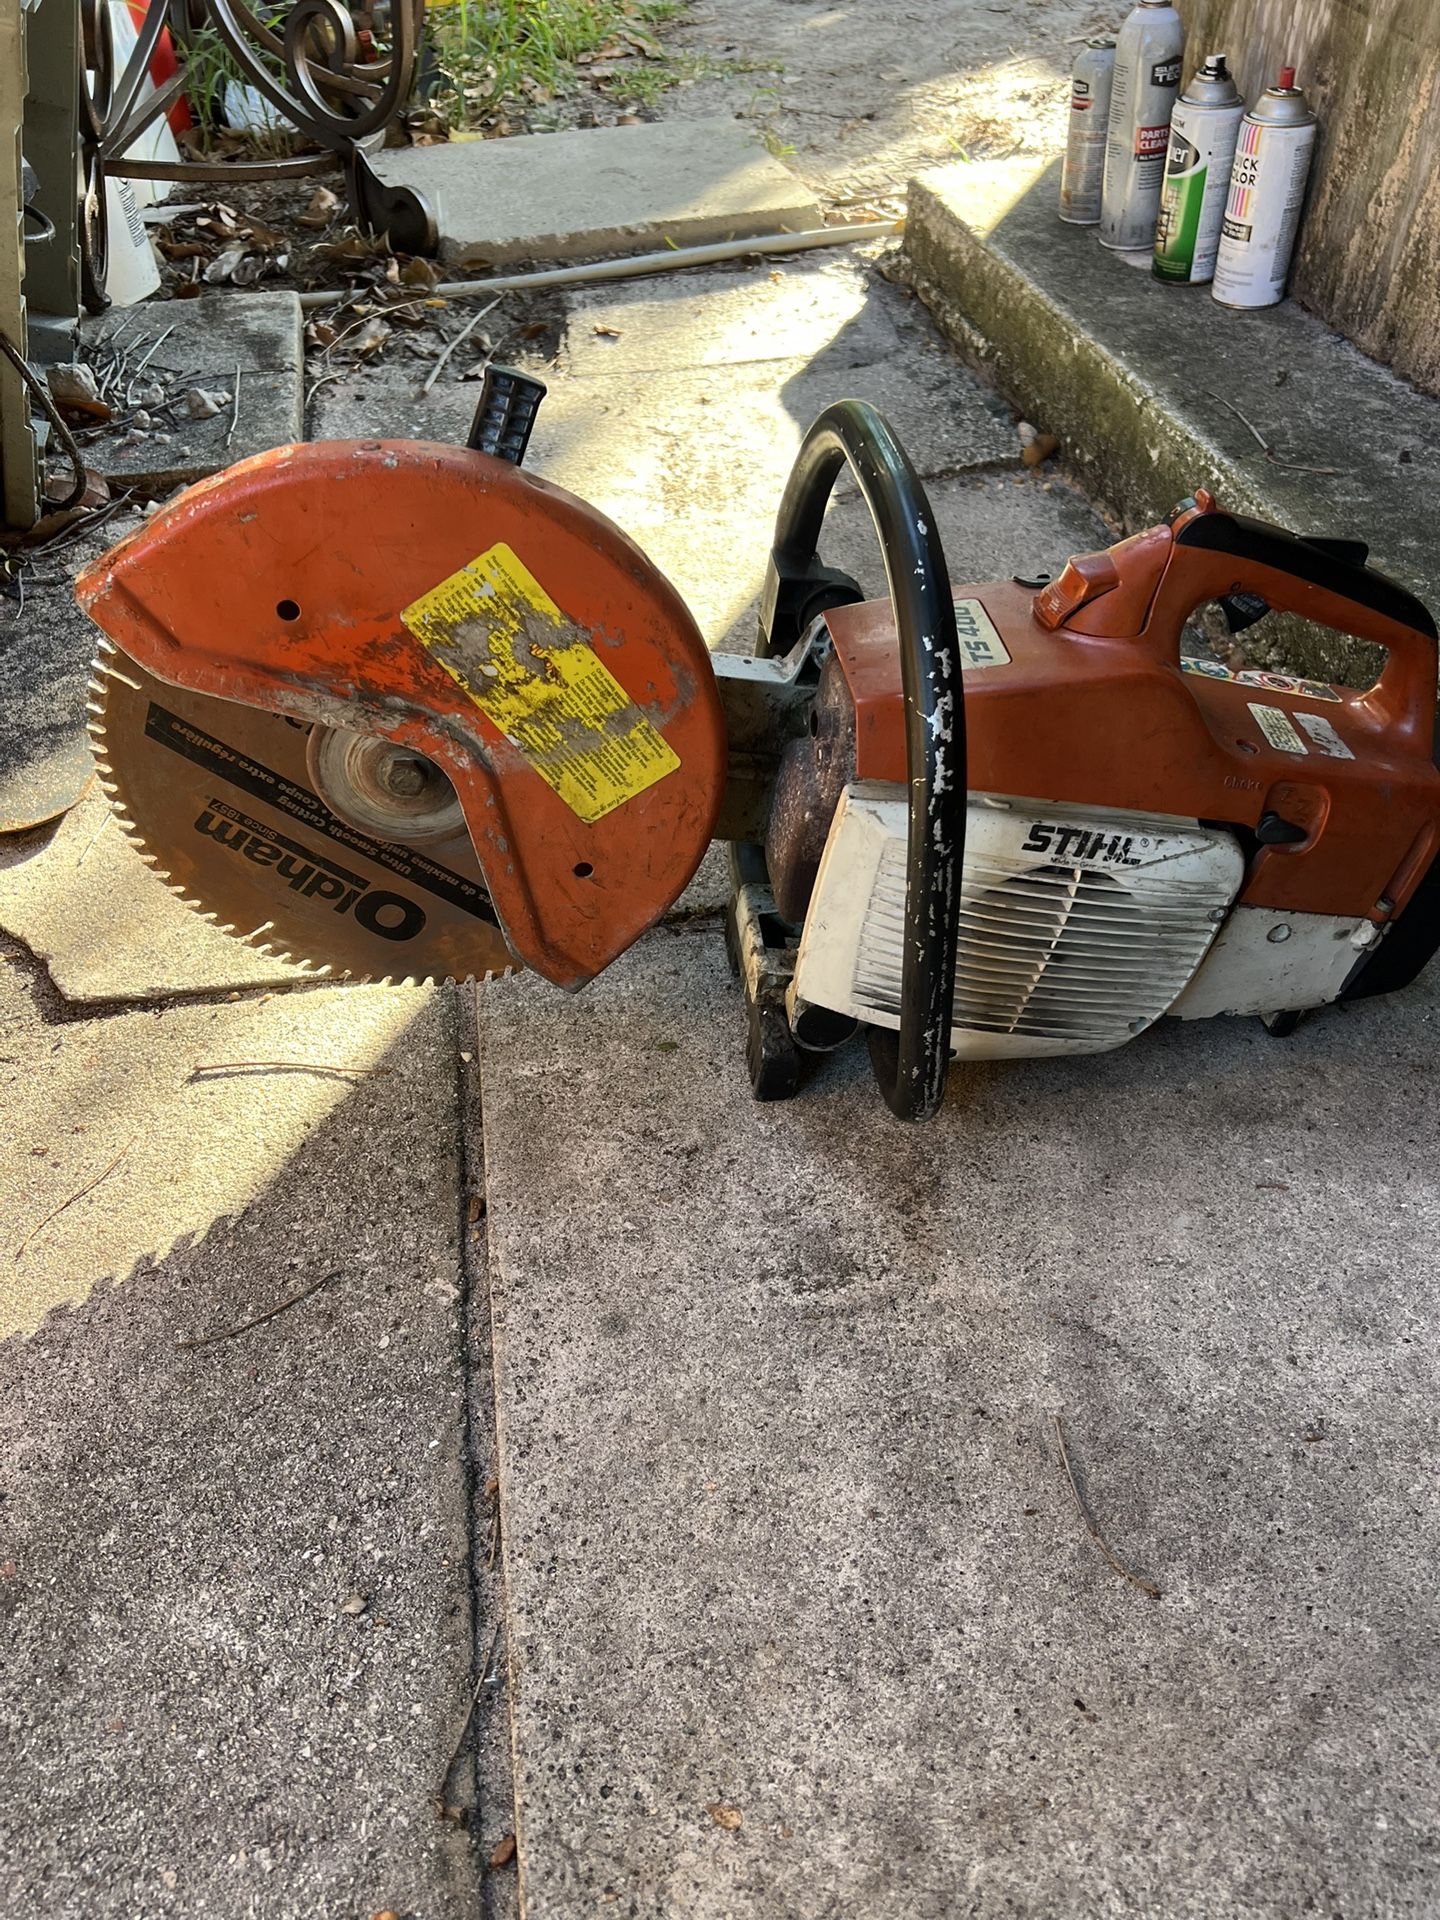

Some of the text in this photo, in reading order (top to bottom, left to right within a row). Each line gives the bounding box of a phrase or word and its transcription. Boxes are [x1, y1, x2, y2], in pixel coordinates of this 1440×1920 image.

[963, 640, 994, 663] TS
[167, 719, 237, 765] régulière
[236, 758, 276, 786] extra
[276, 779, 321, 810] Coupe
[210, 798, 278, 841] Since 1857
[274, 792, 412, 875] Ultra Smooth Cutting
[1021, 824, 1142, 866] STIHL
[193, 809, 427, 942] Oldham
[409, 854, 459, 888] máxima
